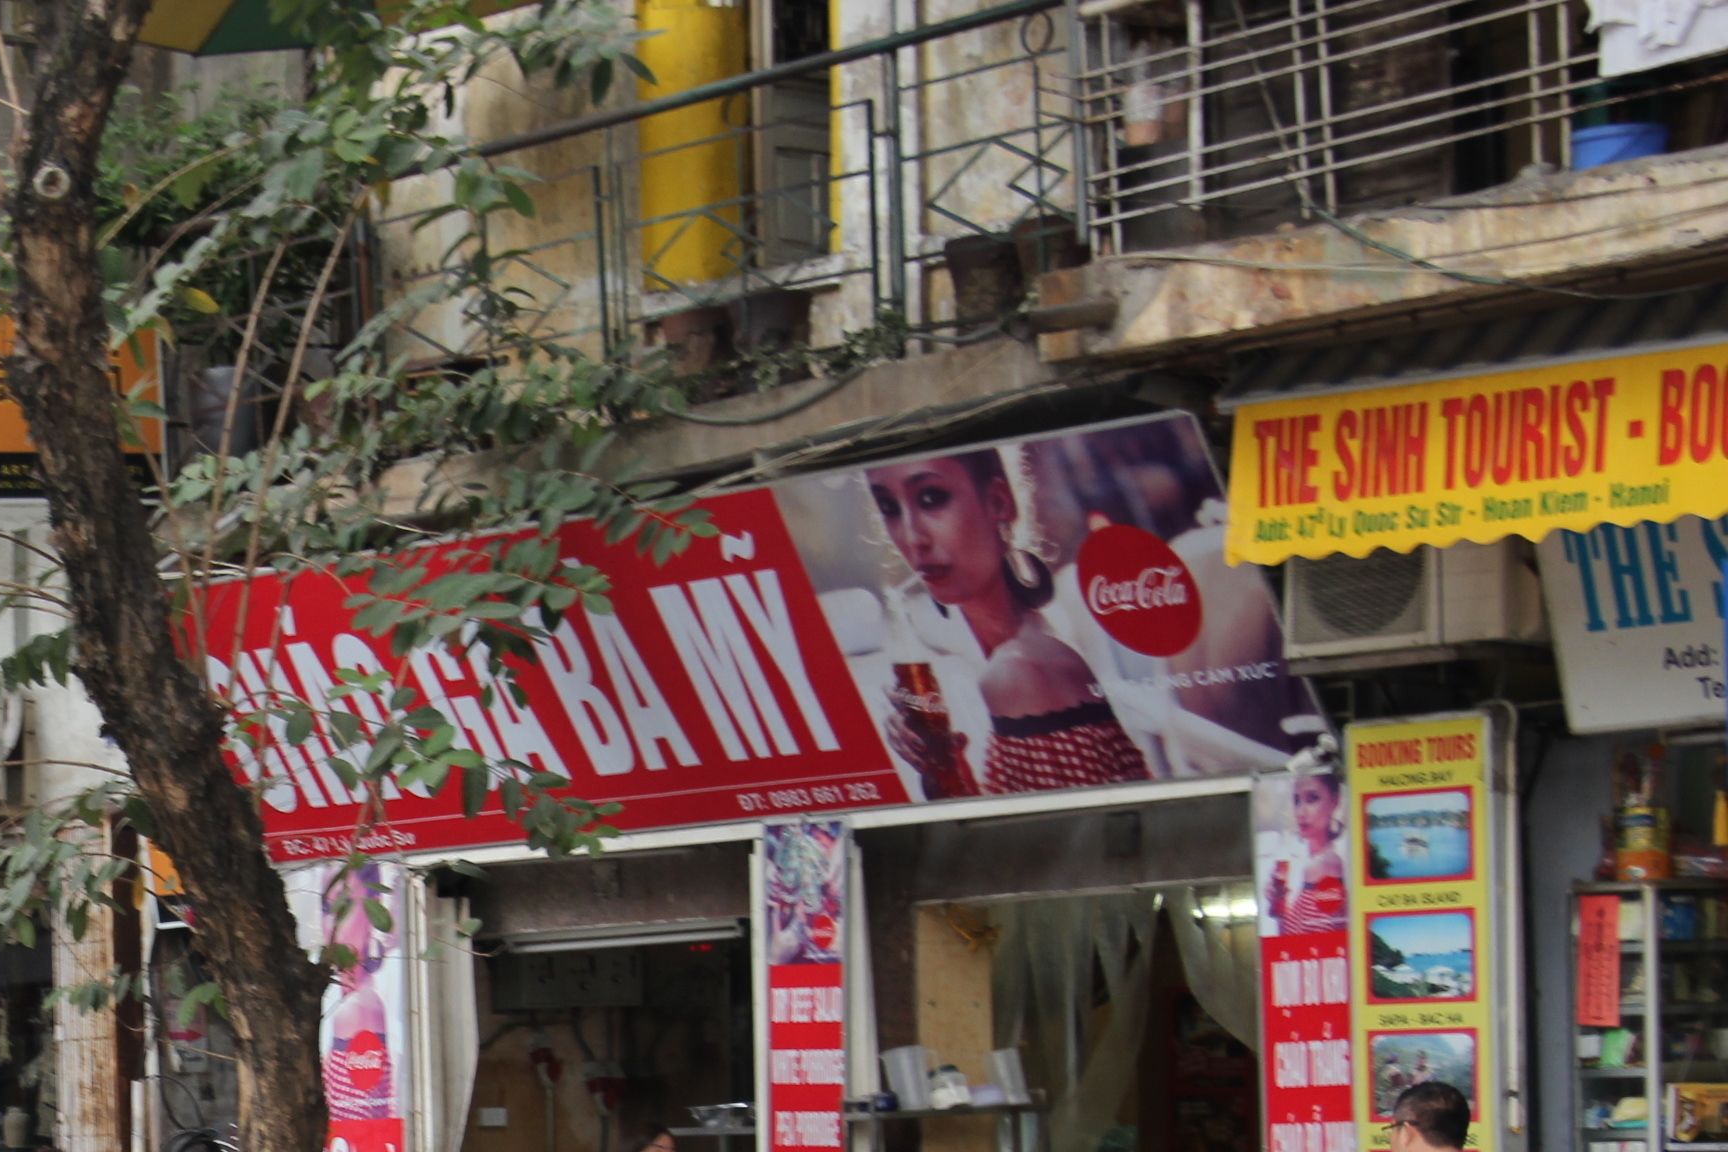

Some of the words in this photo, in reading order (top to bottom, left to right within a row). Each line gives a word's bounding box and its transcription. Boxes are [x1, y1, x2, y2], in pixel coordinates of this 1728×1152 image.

[1254, 413, 1321, 508] THE
[1333, 401, 1429, 502] SINH
[1441, 377, 1616, 491] TOURIST
[1658, 363, 1728, 466] BO
[1483, 496, 1533, 523] Hoan
[1540, 489, 1589, 516] Kiem
[1608, 477, 1670, 509] Hanoi
[1563, 521, 1693, 632] THE
[648, 530, 843, 763] MỸ
[1663, 645, 1718, 671] Add:
[1696, 676, 1727, 700] Te
[1357, 738, 1422, 769] BOOKING
[1425, 732, 1476, 763] TOURS
